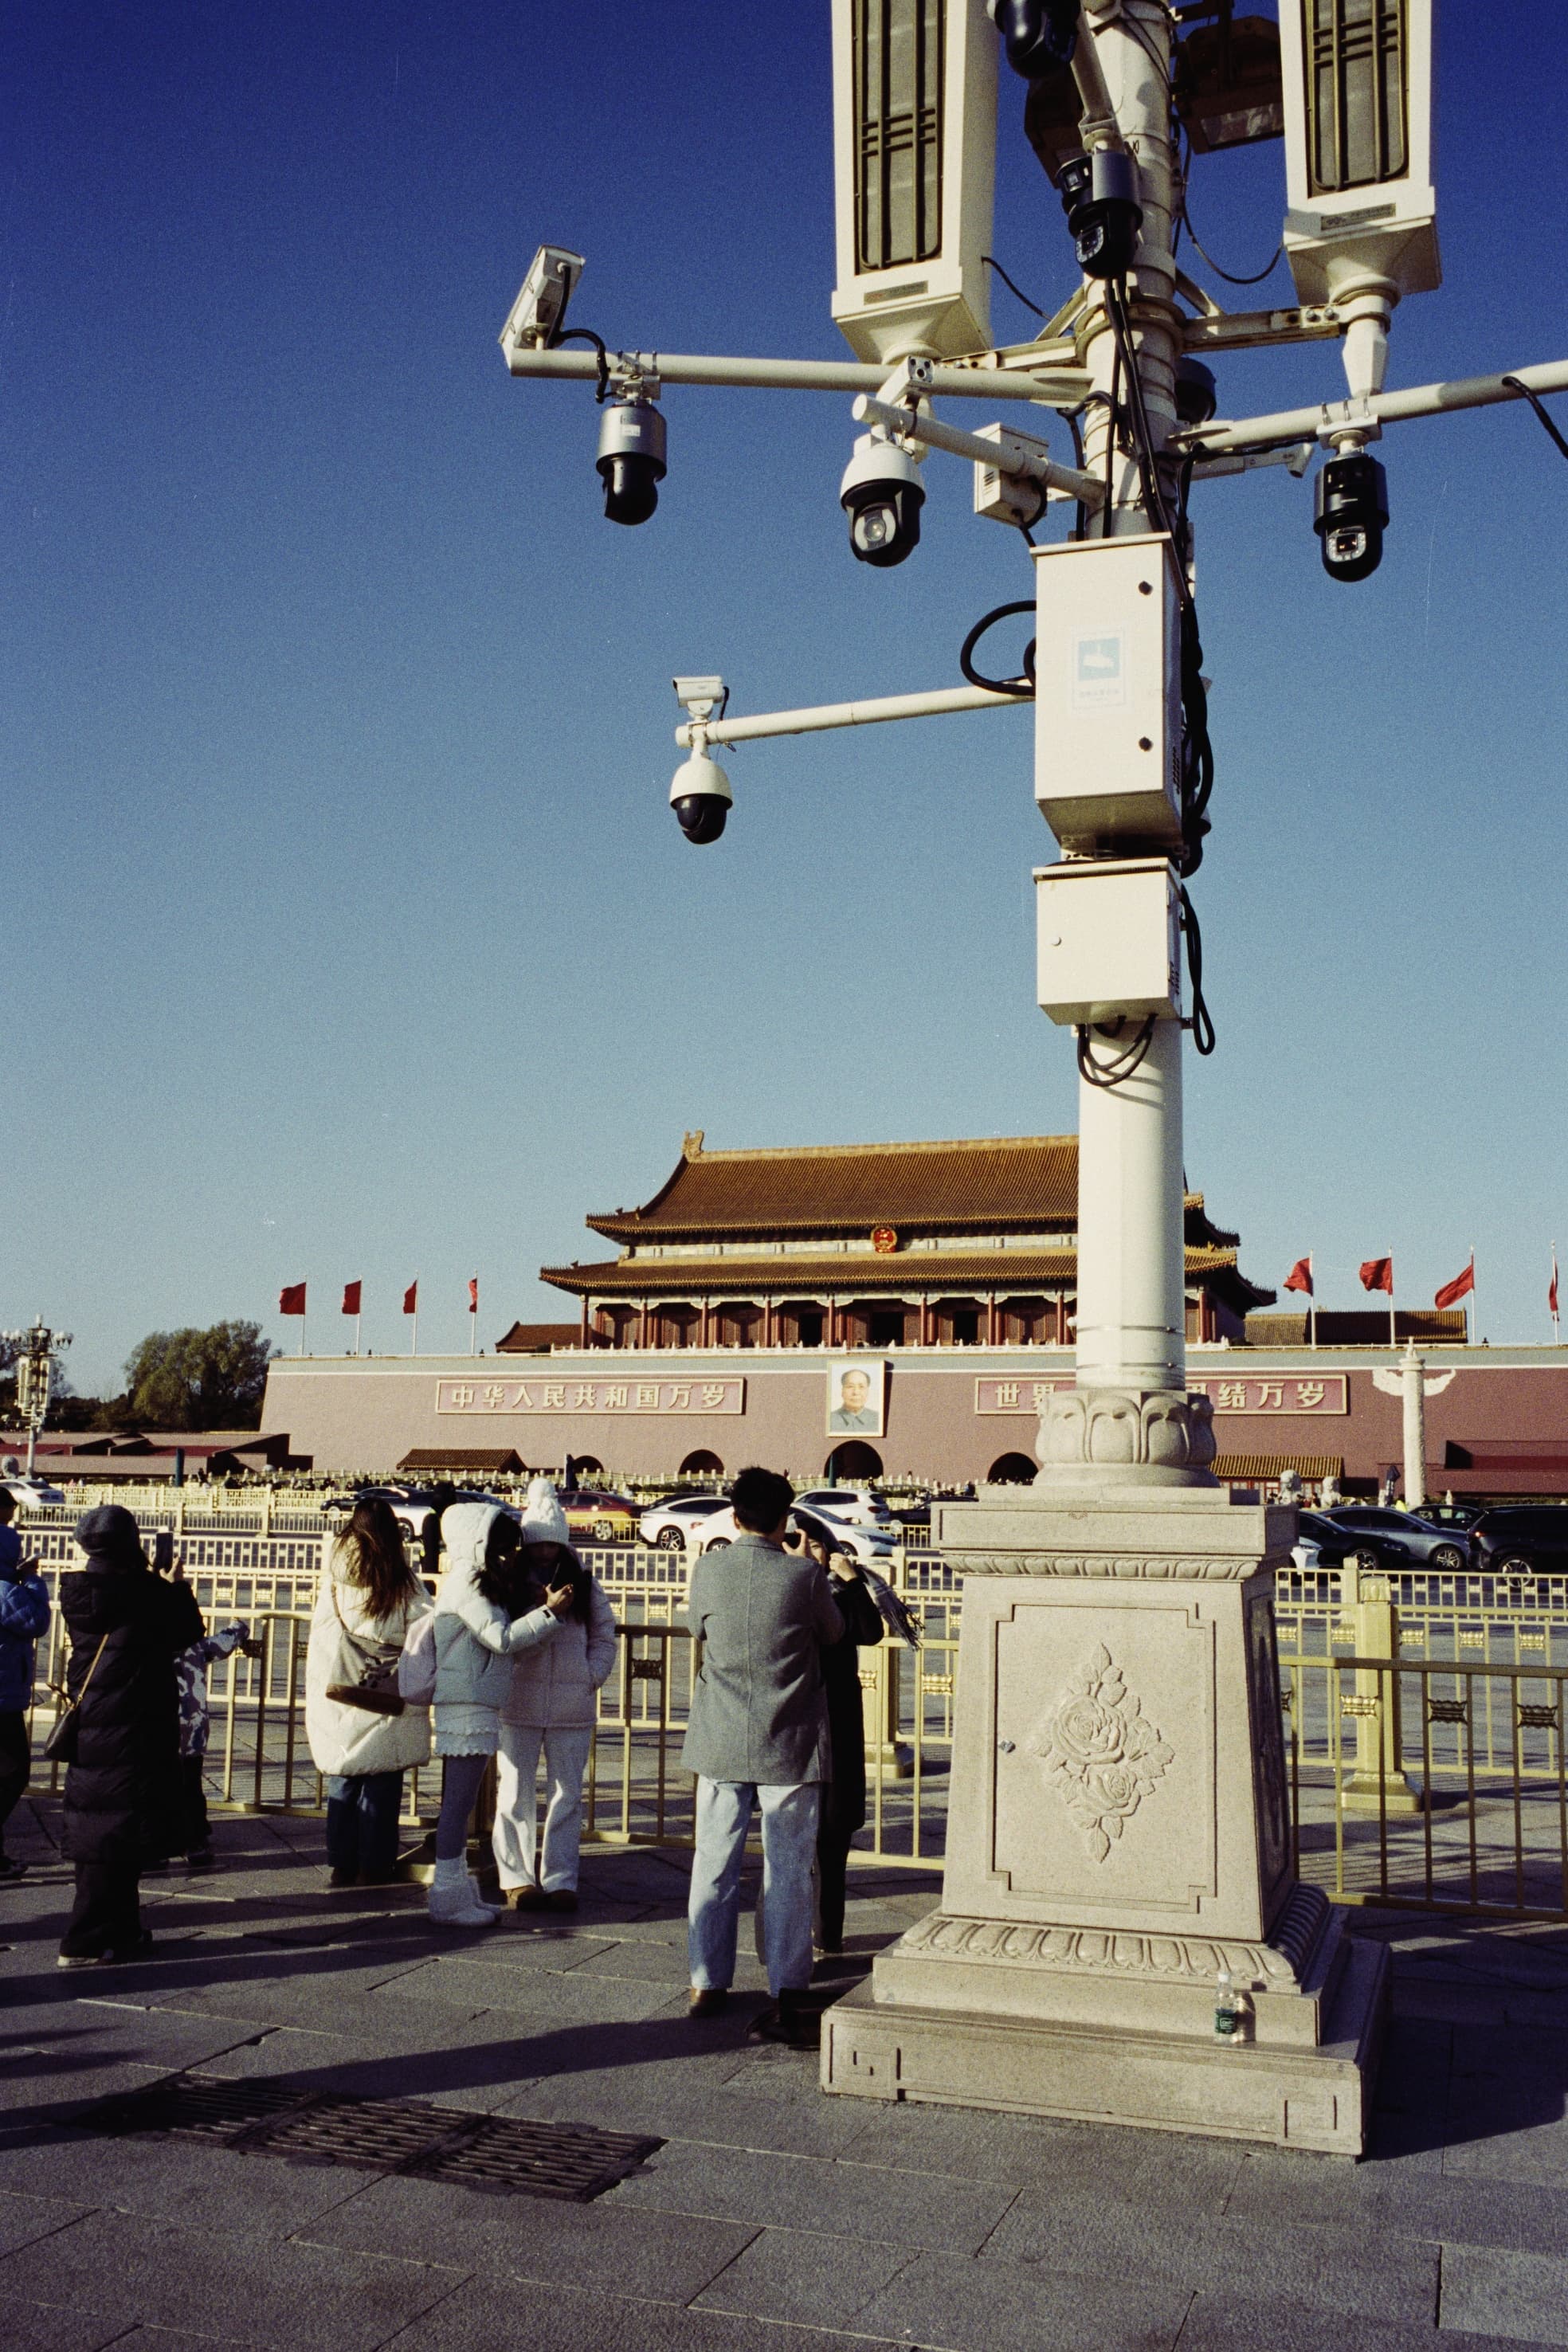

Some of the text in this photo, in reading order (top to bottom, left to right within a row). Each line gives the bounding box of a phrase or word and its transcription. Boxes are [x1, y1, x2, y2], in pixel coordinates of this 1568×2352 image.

[450, 1384, 727, 1409] 中华人民共和国万岁
